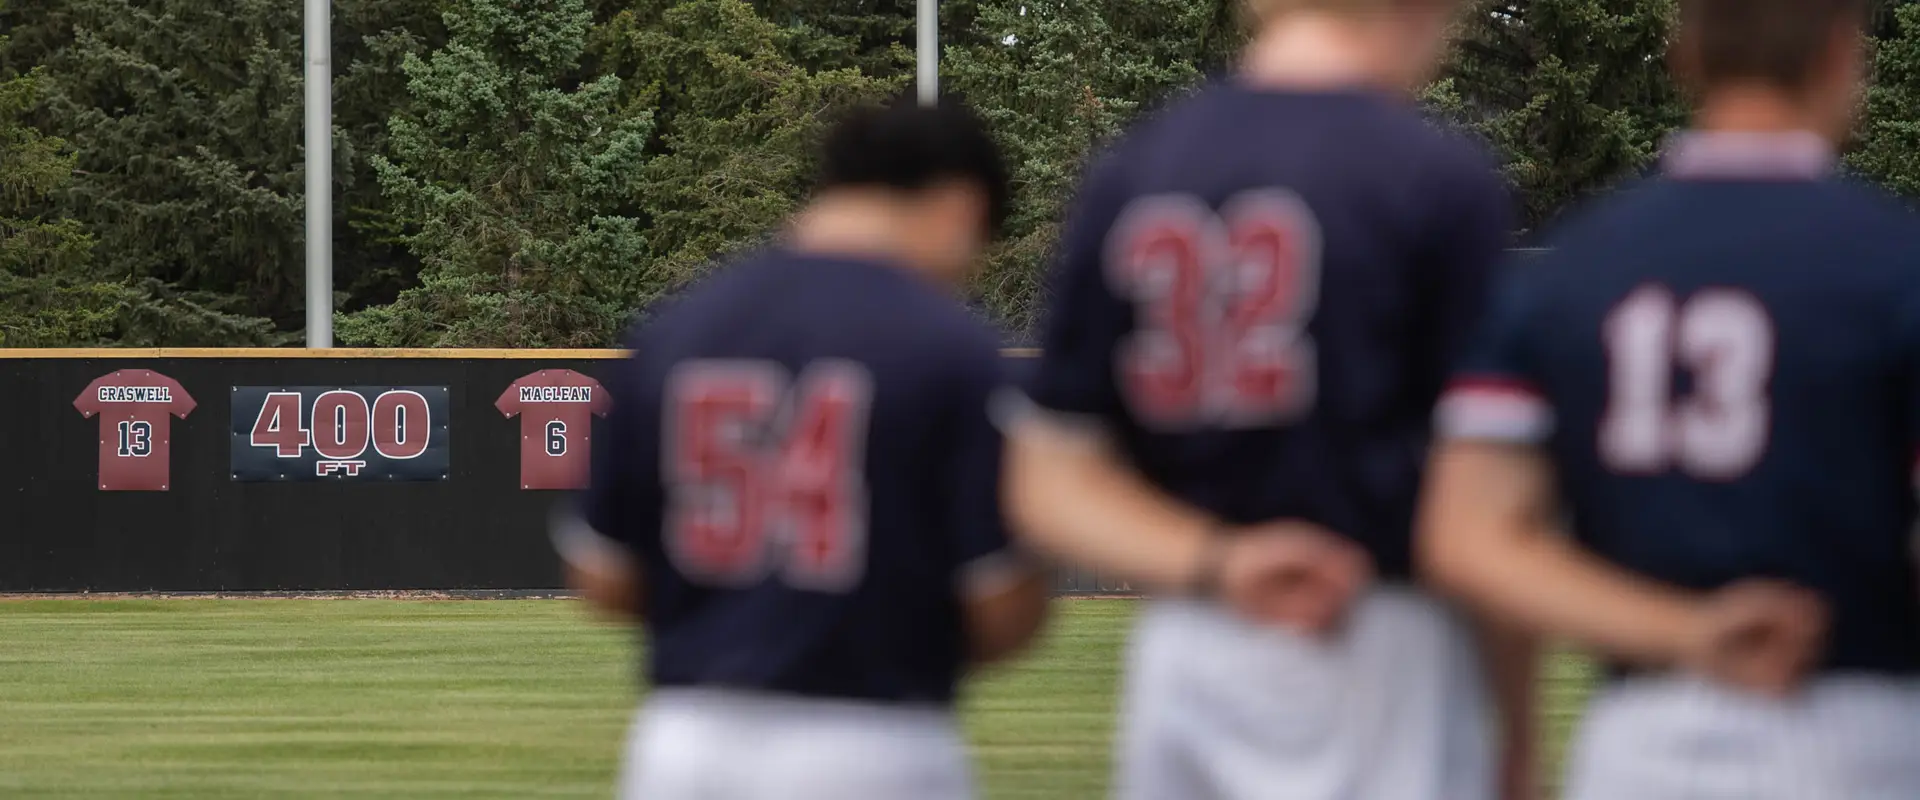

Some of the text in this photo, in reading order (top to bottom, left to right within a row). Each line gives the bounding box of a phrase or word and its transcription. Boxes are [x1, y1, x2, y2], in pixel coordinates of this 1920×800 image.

[1103, 187, 1323, 431] 32
[98, 387, 172, 403] CRASWELL
[519, 386, 591, 402] MACLEAN
[1598, 281, 1776, 482] 13
[117, 420, 152, 457] 13
[250, 390, 431, 459] 400
[545, 420, 567, 457] 6
[316, 460, 366, 476] FT
[661, 358, 874, 592] 54
